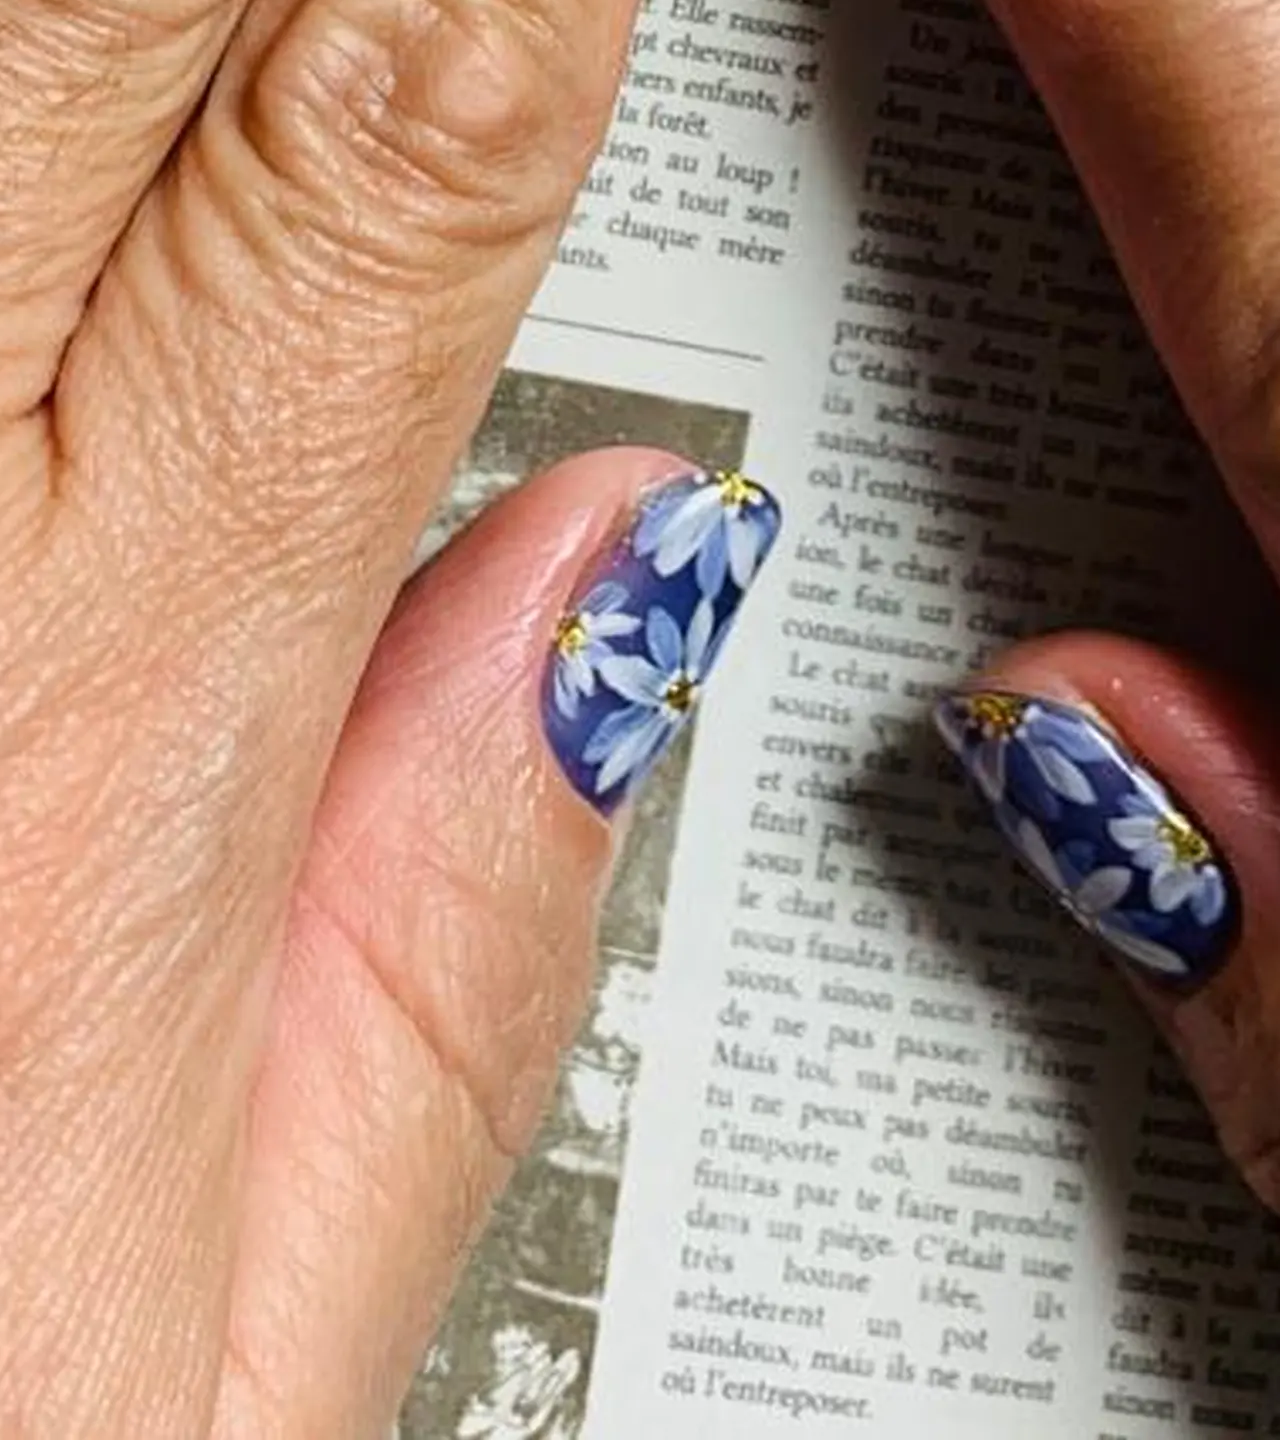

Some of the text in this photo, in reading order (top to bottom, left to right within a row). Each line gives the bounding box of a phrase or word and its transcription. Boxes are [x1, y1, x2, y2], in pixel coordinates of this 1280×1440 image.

[666, 149, 699, 173] au
[717, 150, 773, 193] loup
[630, 175, 790, 228] de tout son
[608, 212, 701, 250] chaque
[711, 1039, 992, 1108] Mais petite
[700, 1121, 839, 1165] n'importe
[895, 1189, 958, 1224] faire
[782, 1258, 872, 1293] bonne
[1022, 1254, 1073, 1281] une
[940, 1326, 989, 1354] pot
